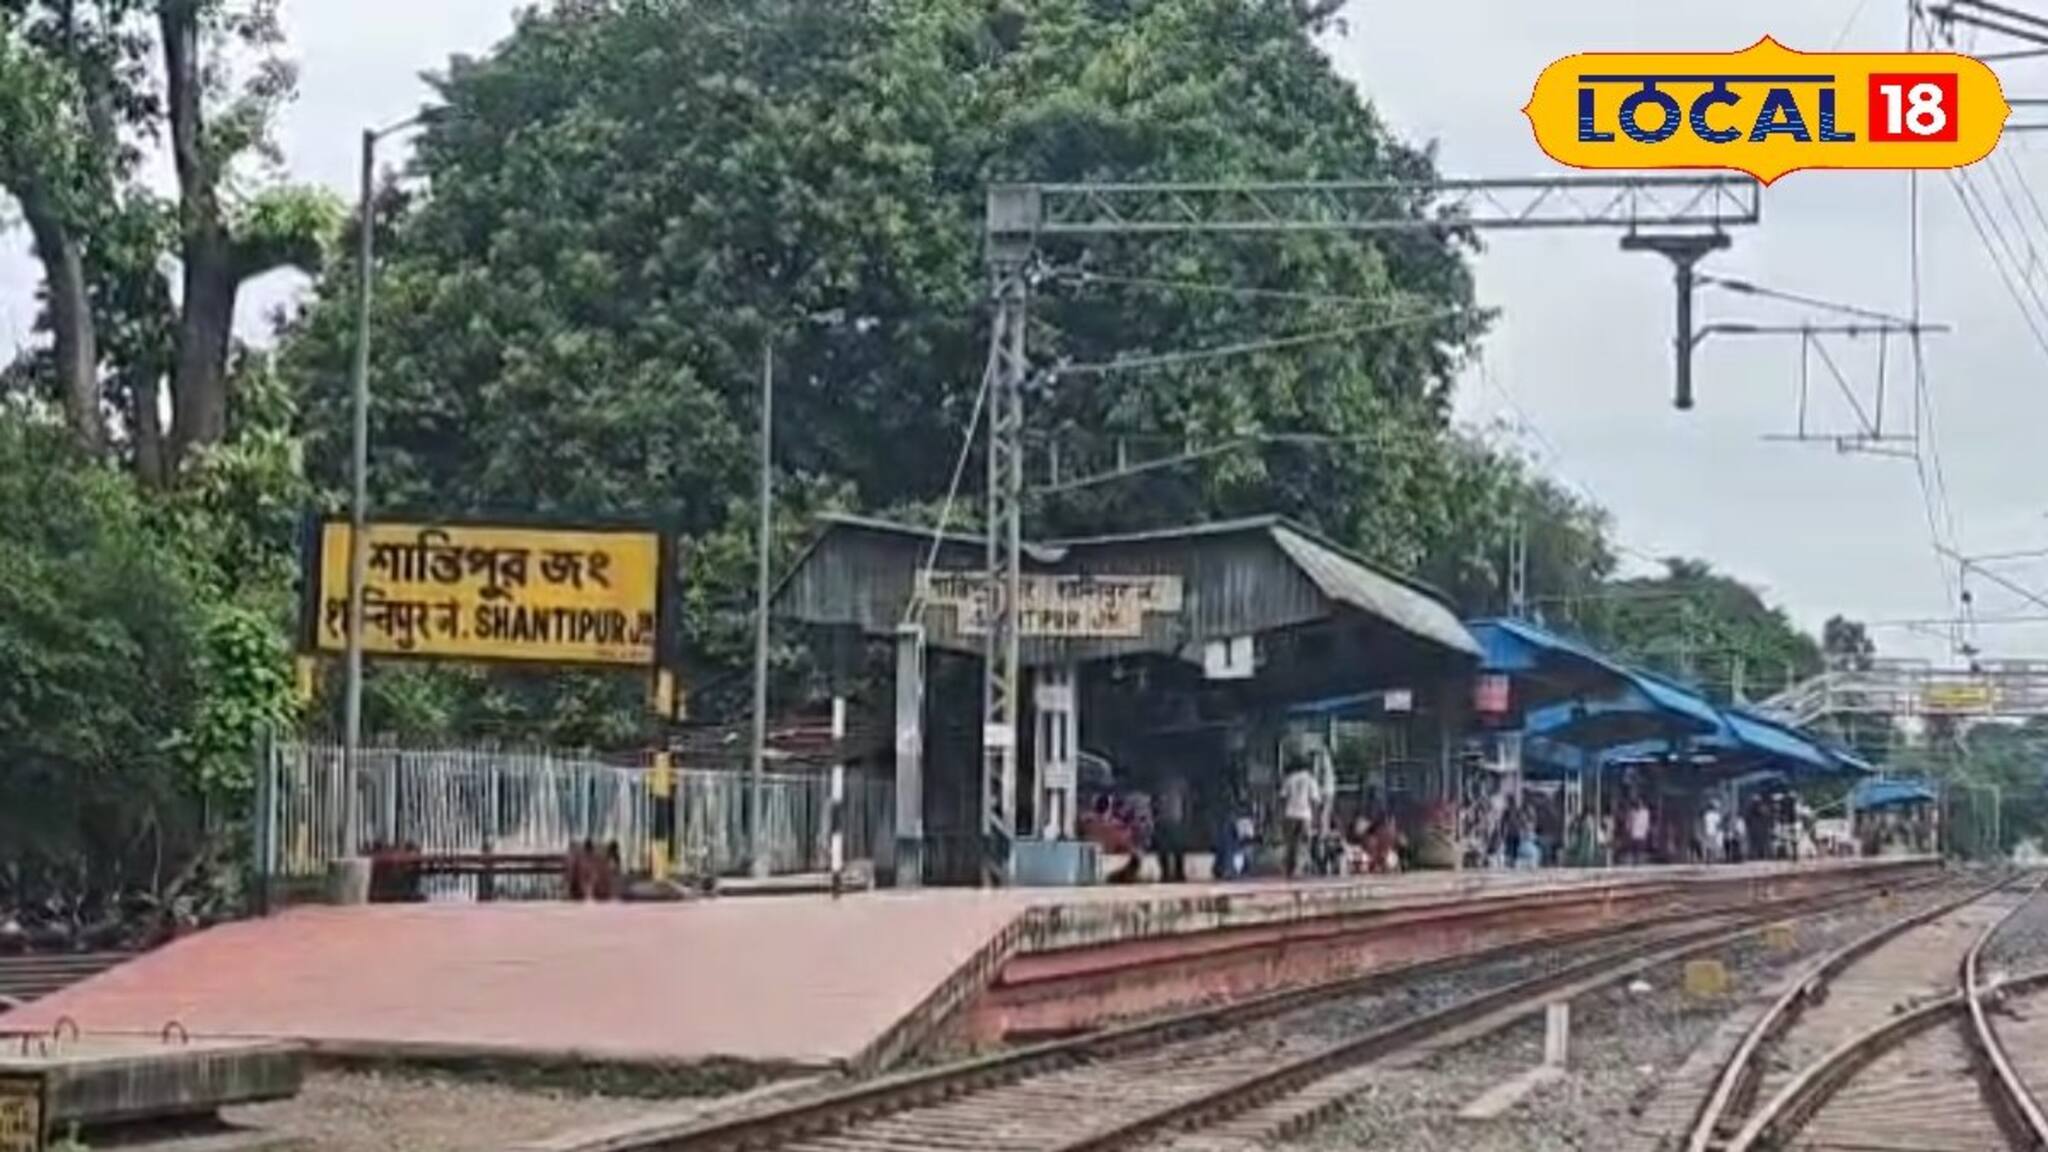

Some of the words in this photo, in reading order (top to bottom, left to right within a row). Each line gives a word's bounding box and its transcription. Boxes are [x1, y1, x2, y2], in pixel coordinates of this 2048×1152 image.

[369, 530, 532, 601] শান্তিপুর
[539, 549, 610, 589] জং
[474, 605, 626, 645] SHANTIPUR
